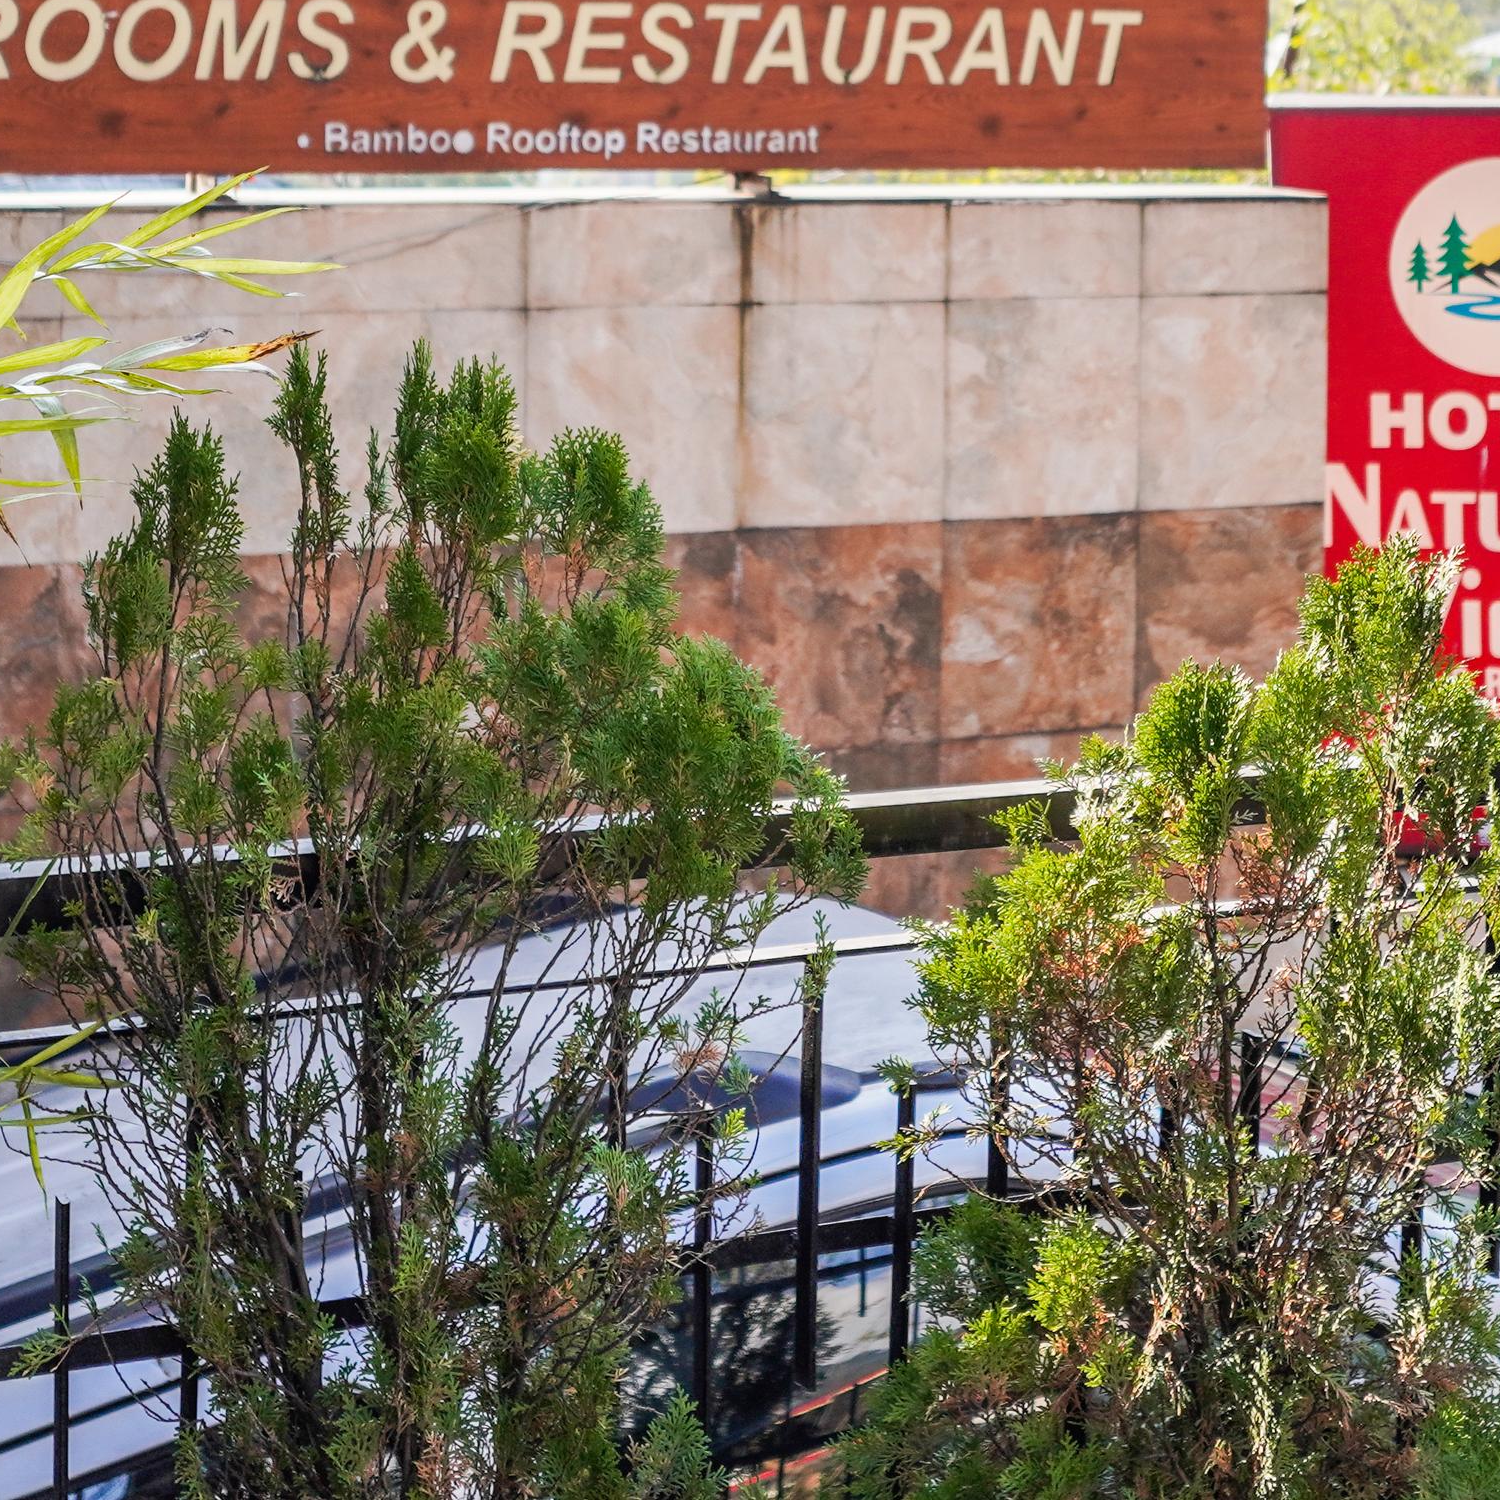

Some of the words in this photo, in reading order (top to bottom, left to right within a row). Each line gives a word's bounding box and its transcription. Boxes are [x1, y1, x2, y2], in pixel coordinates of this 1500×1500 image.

[490, 0, 1143, 86] RESTAURANT
[324, 121, 475, 155] Bamboo
[486, 121, 625, 160] Rooftop
[636, 122, 820, 155] Restaurant
